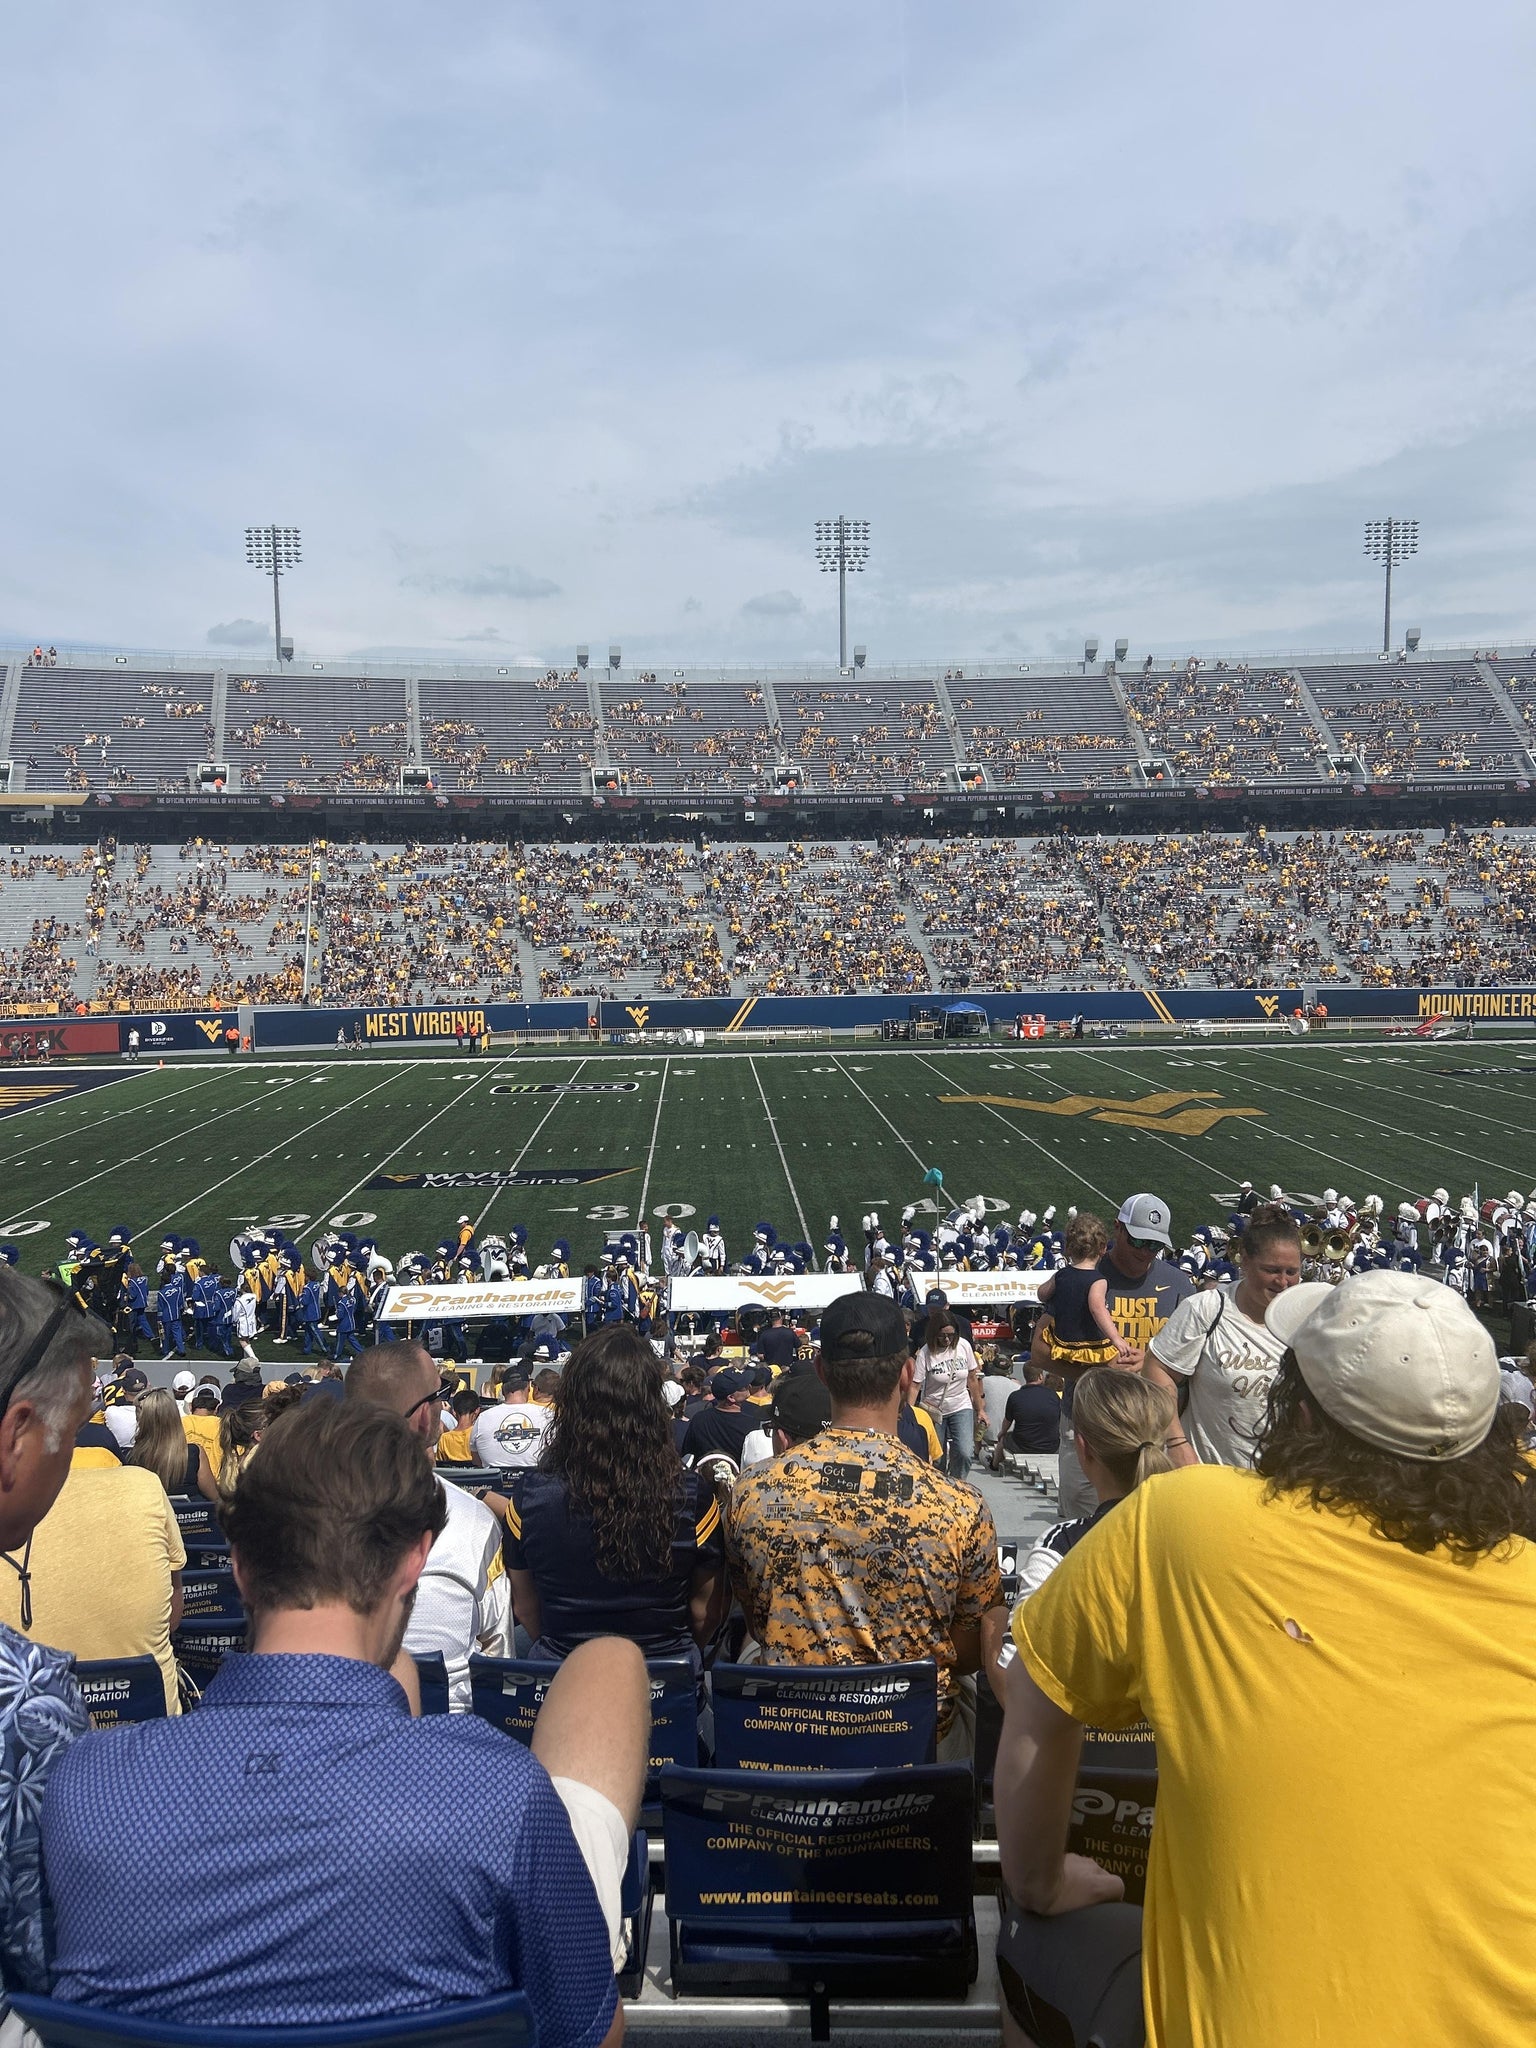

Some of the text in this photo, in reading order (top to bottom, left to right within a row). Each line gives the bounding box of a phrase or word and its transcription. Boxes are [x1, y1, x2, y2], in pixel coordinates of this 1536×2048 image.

[135, 998, 211, 1010] OUNTAINEER MANIACS
[366, 1010, 485, 1037] WEST VIRGINIA
[422, 1178, 579, 1188] Medicine
[425, 1171, 518, 1180] WVU
[961, 1276, 1041, 1292] Panha
[431, 1289, 577, 1305] Panhandle
[961, 1290, 1016, 1298] CLEANING
[428, 1303, 484, 1312] CLEANING
[498, 1300, 573, 1308] RESTORATION
[1111, 1296, 1158, 1318] JUST
[972, 1328, 997, 1336] RADE
[776, 1691, 826, 1701] CLEANING
[839, 1693, 907, 1705] RESTORATION
[519, 1706, 537, 1718] THE
[759, 1706, 893, 1723] THE OFFICIAL RESTORATION
[505, 1717, 536, 1728] COMP
[744, 1719, 794, 1733] COMPANY
[795, 1722, 808, 1733] OF
[809, 1723, 828, 1736] THE
[1097, 1732, 1155, 1742] MOUNTAINE
[752, 1793, 935, 1816] Panhandle
[750, 1804, 929, 1827] CLEANING & RESTORATION
[727, 1822, 910, 1846] THE OFFICIAL RESTORATION
[1112, 1823, 1153, 1838] CLEA
[707, 1837, 773, 1851] COMPANY
[777, 1844, 794, 1856] OF
[796, 1845, 822, 1858] THE
[1084, 1837, 1111, 1853] THE
[699, 1891, 939, 1905] www.mountaineerseats.com
